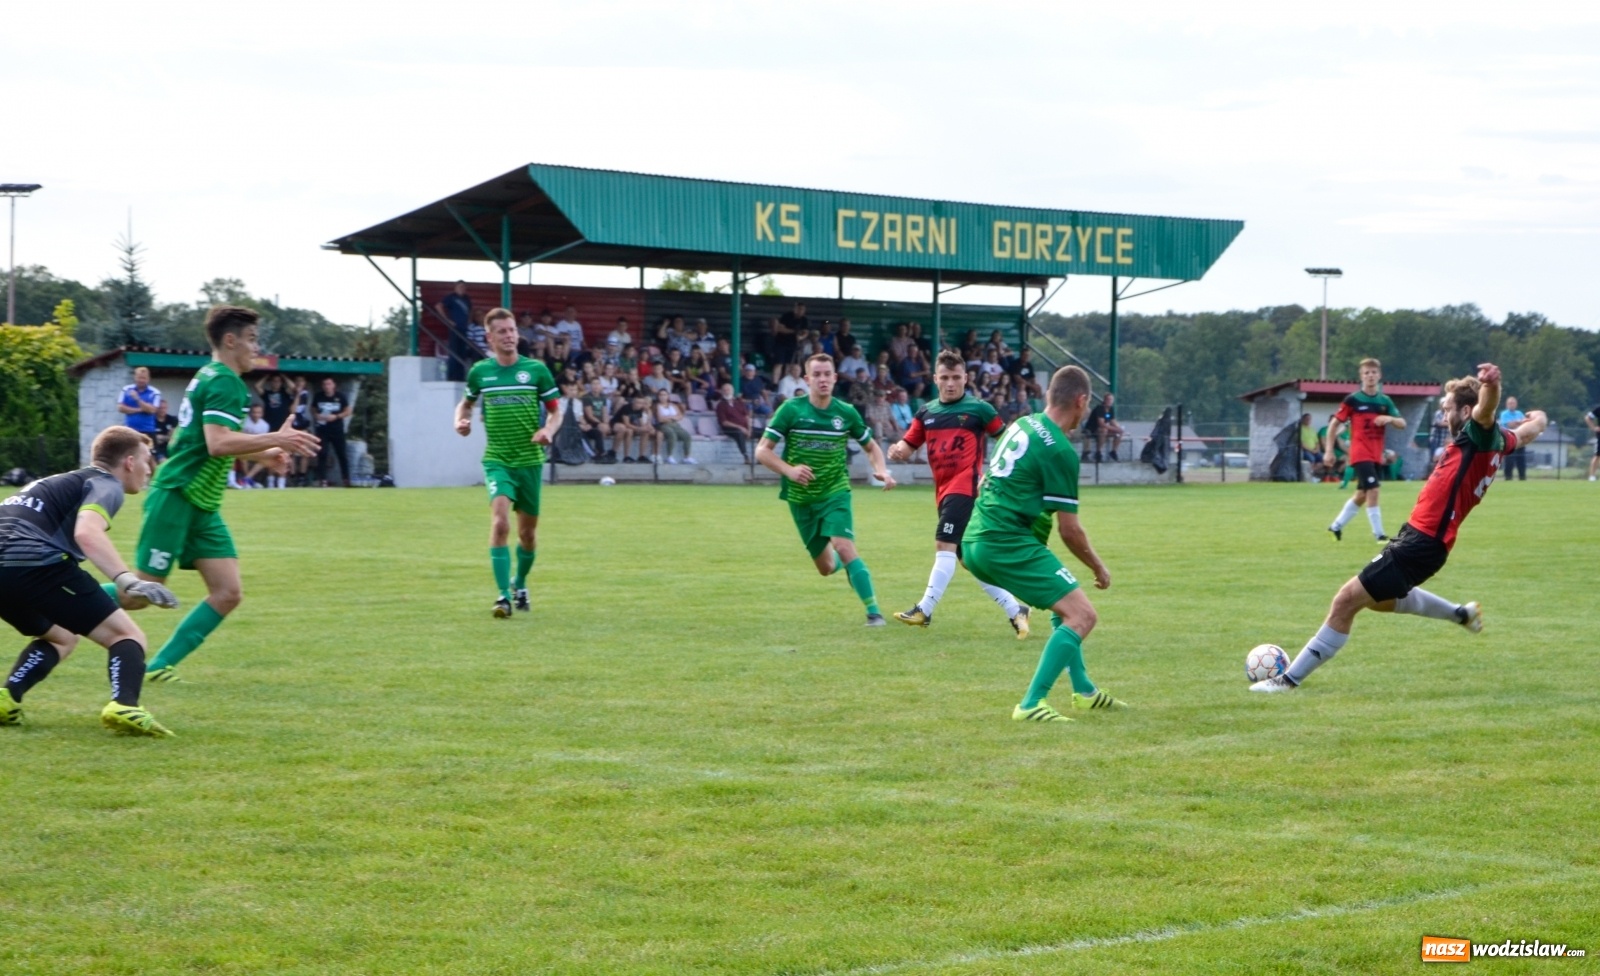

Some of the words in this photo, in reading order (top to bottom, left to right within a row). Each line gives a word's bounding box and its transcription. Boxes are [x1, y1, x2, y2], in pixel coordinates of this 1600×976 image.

[755, 201, 801, 244] KS
[837, 209, 957, 255] CZARNI
[993, 220, 1133, 264] GORZYCE
[943, 522, 955, 535] 23
